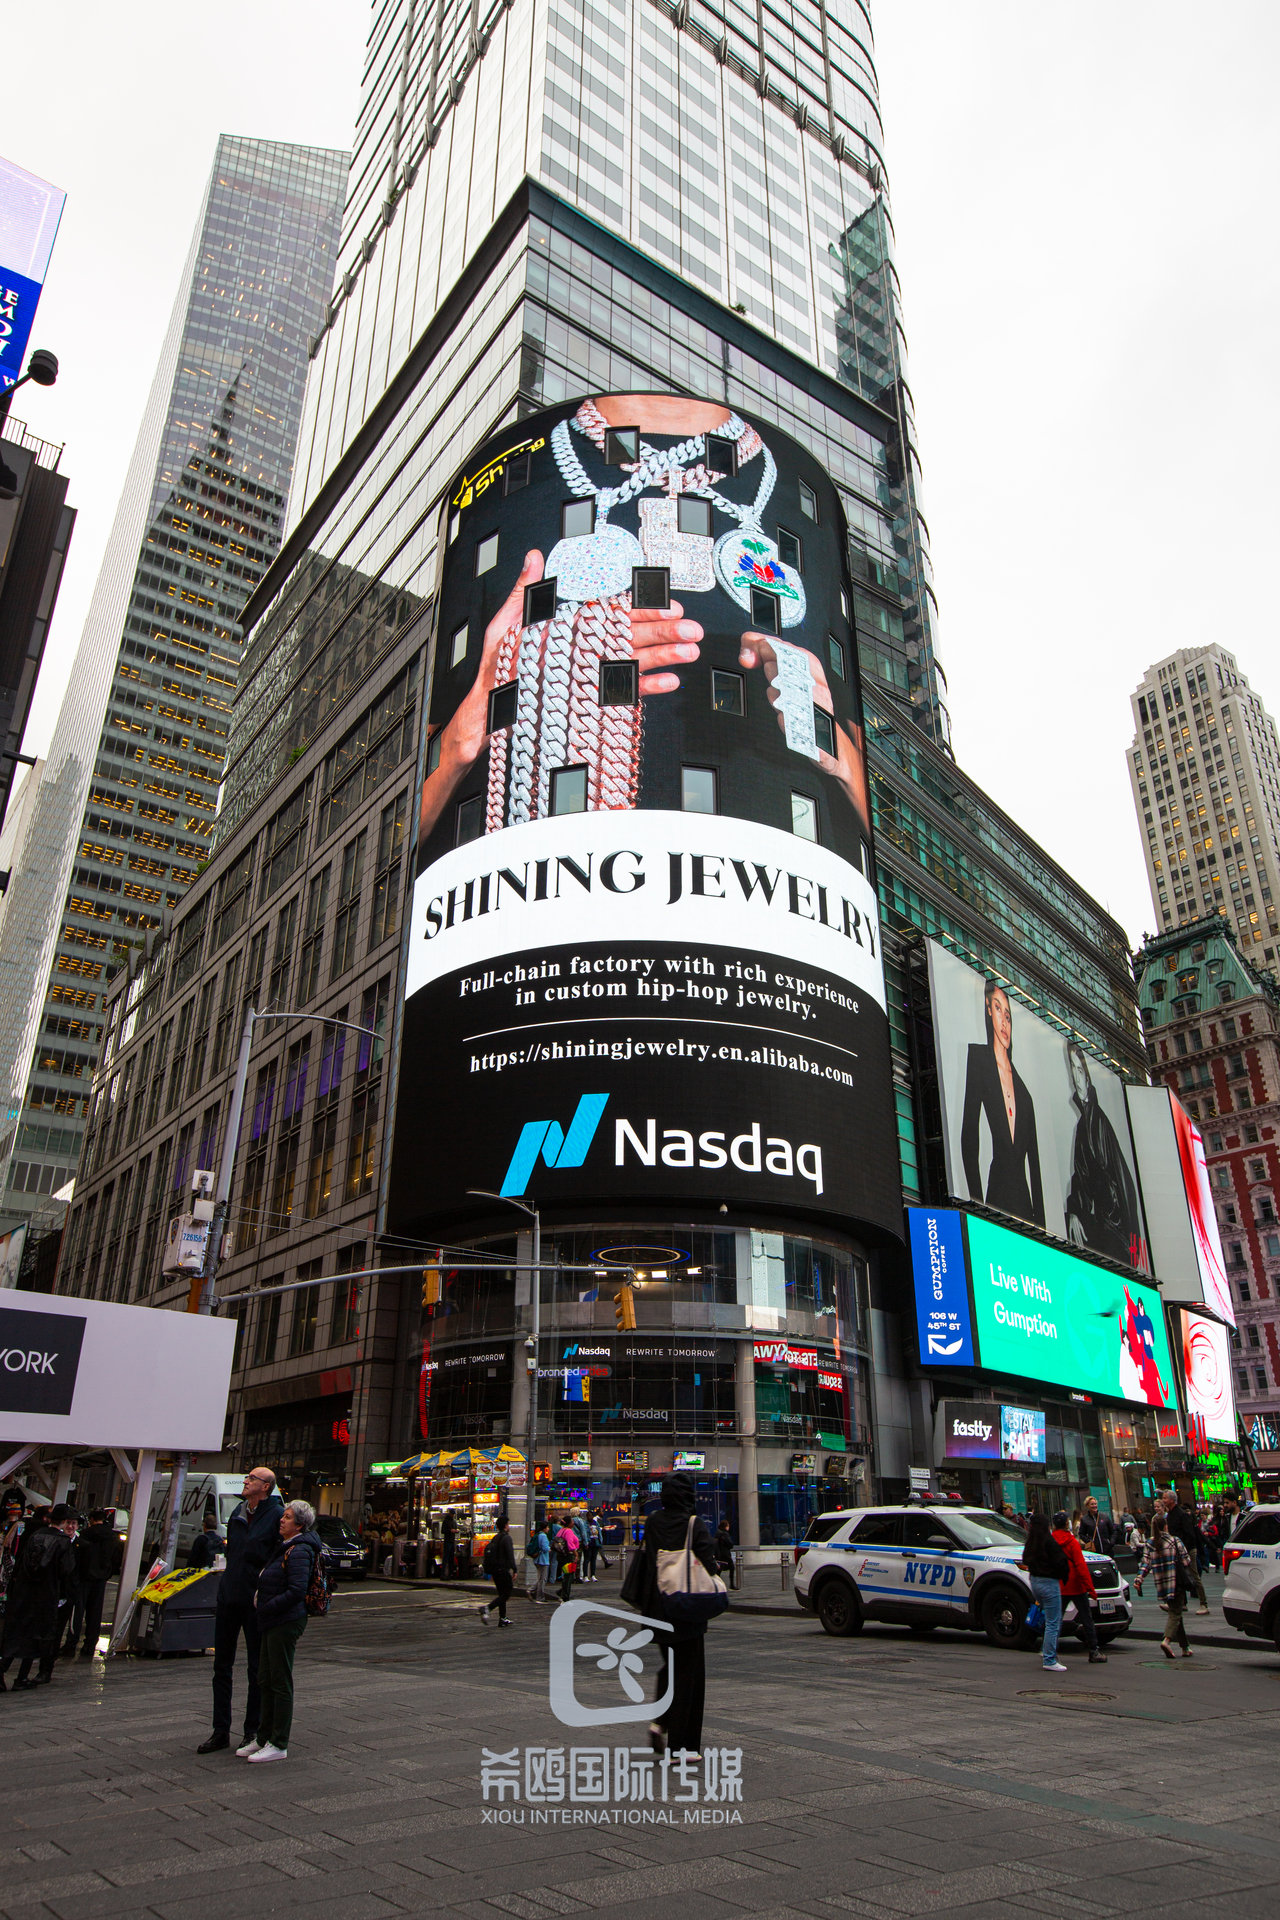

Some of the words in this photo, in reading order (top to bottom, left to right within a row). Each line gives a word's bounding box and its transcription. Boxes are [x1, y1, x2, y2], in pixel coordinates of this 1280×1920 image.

[424, 850, 646, 940] SHINING
[665, 851, 877, 960] JEWELRY
[459, 960, 561, 998] Full-chain
[570, 956, 656, 976] factory
[665, 955, 715, 975] with
[724, 961, 768, 984] rich
[774, 970, 860, 1015] experience
[515, 987, 536, 1006] in
[544, 982, 628, 1002] custom
[637, 977, 729, 1004] hip-hop
[736, 987, 817, 1020] jewelry.
[469, 1037, 854, 1088] https://shiningjewelry.en.alibaba.com
[615, 1118, 824, 1195] Nasdaq
[927, 1218, 944, 1301] GUMPTION
[989, 1262, 1018, 1293] Live
[1020, 1273, 1052, 1304] With
[929, 1311, 947, 1320] 106
[947, 1312, 958, 1321] W
[948, 1322, 961, 1331] ST
[993, 1300, 1058, 1340] Gumption
[0, 1348, 59, 1375] ORK
[578, 1346, 611, 1357] Nasdaq
[626, 1348, 664, 1356] REWRITE
[667, 1348, 716, 1357] TOMORROW
[622, 1408, 669, 1422] Nasdaq
[1012, 1412, 1036, 1430] STAY
[1009, 1432, 1039, 1457] SAFE
[903, 1561, 956, 1588] NYPD
